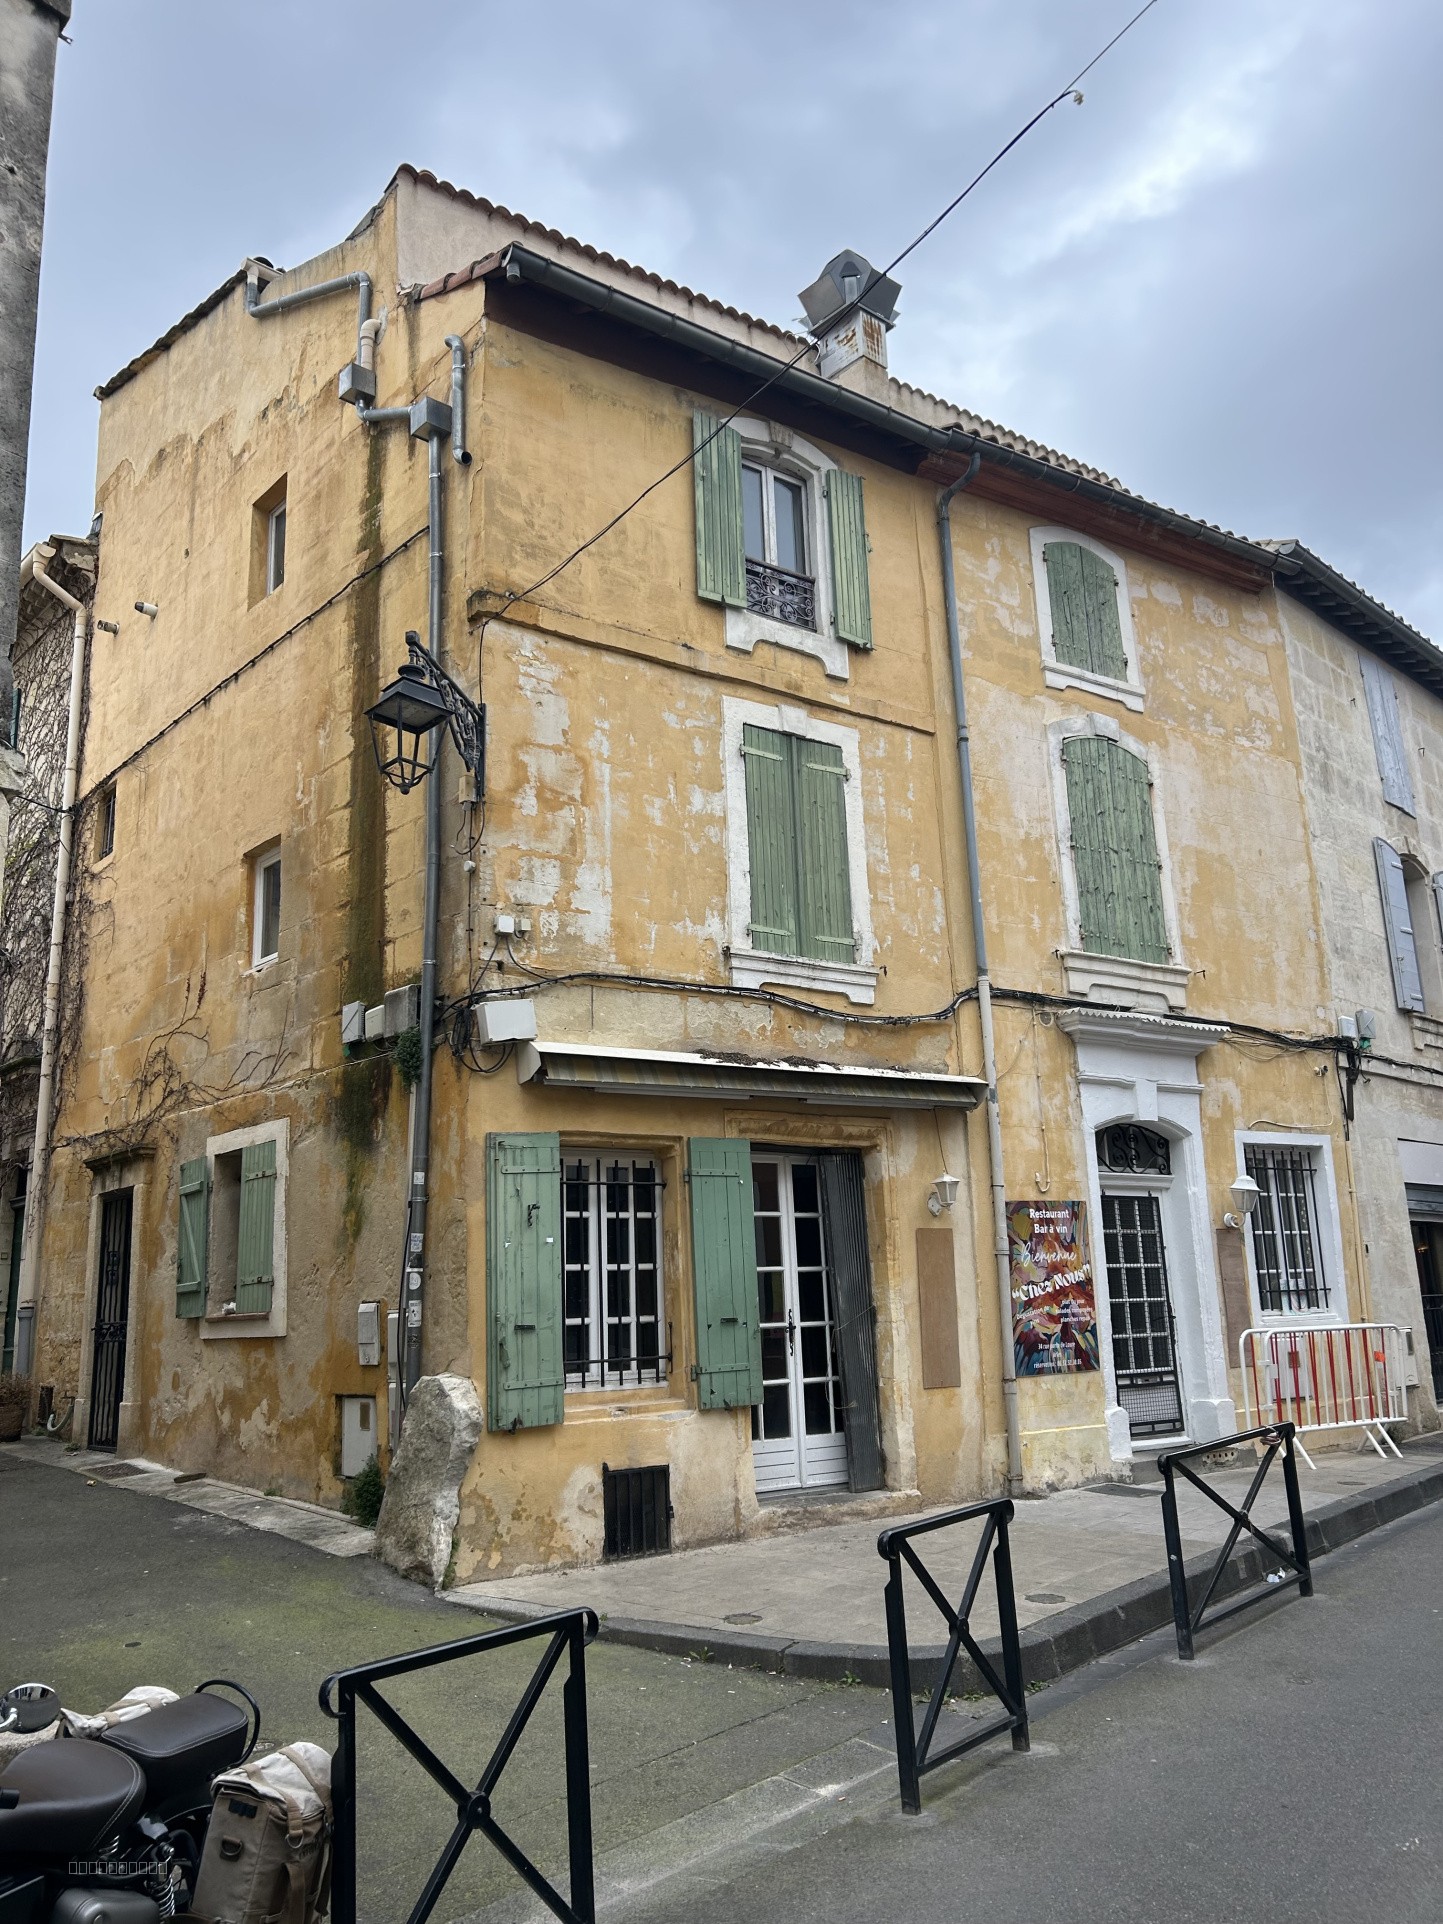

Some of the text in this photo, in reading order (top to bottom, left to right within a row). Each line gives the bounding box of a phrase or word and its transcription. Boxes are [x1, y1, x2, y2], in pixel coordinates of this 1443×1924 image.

[1029, 1208, 1070, 1219] Restaurant
[1034, 1223, 1068, 1234] Bar à vin
[1021, 1242, 1077, 1267] Bienvenue
